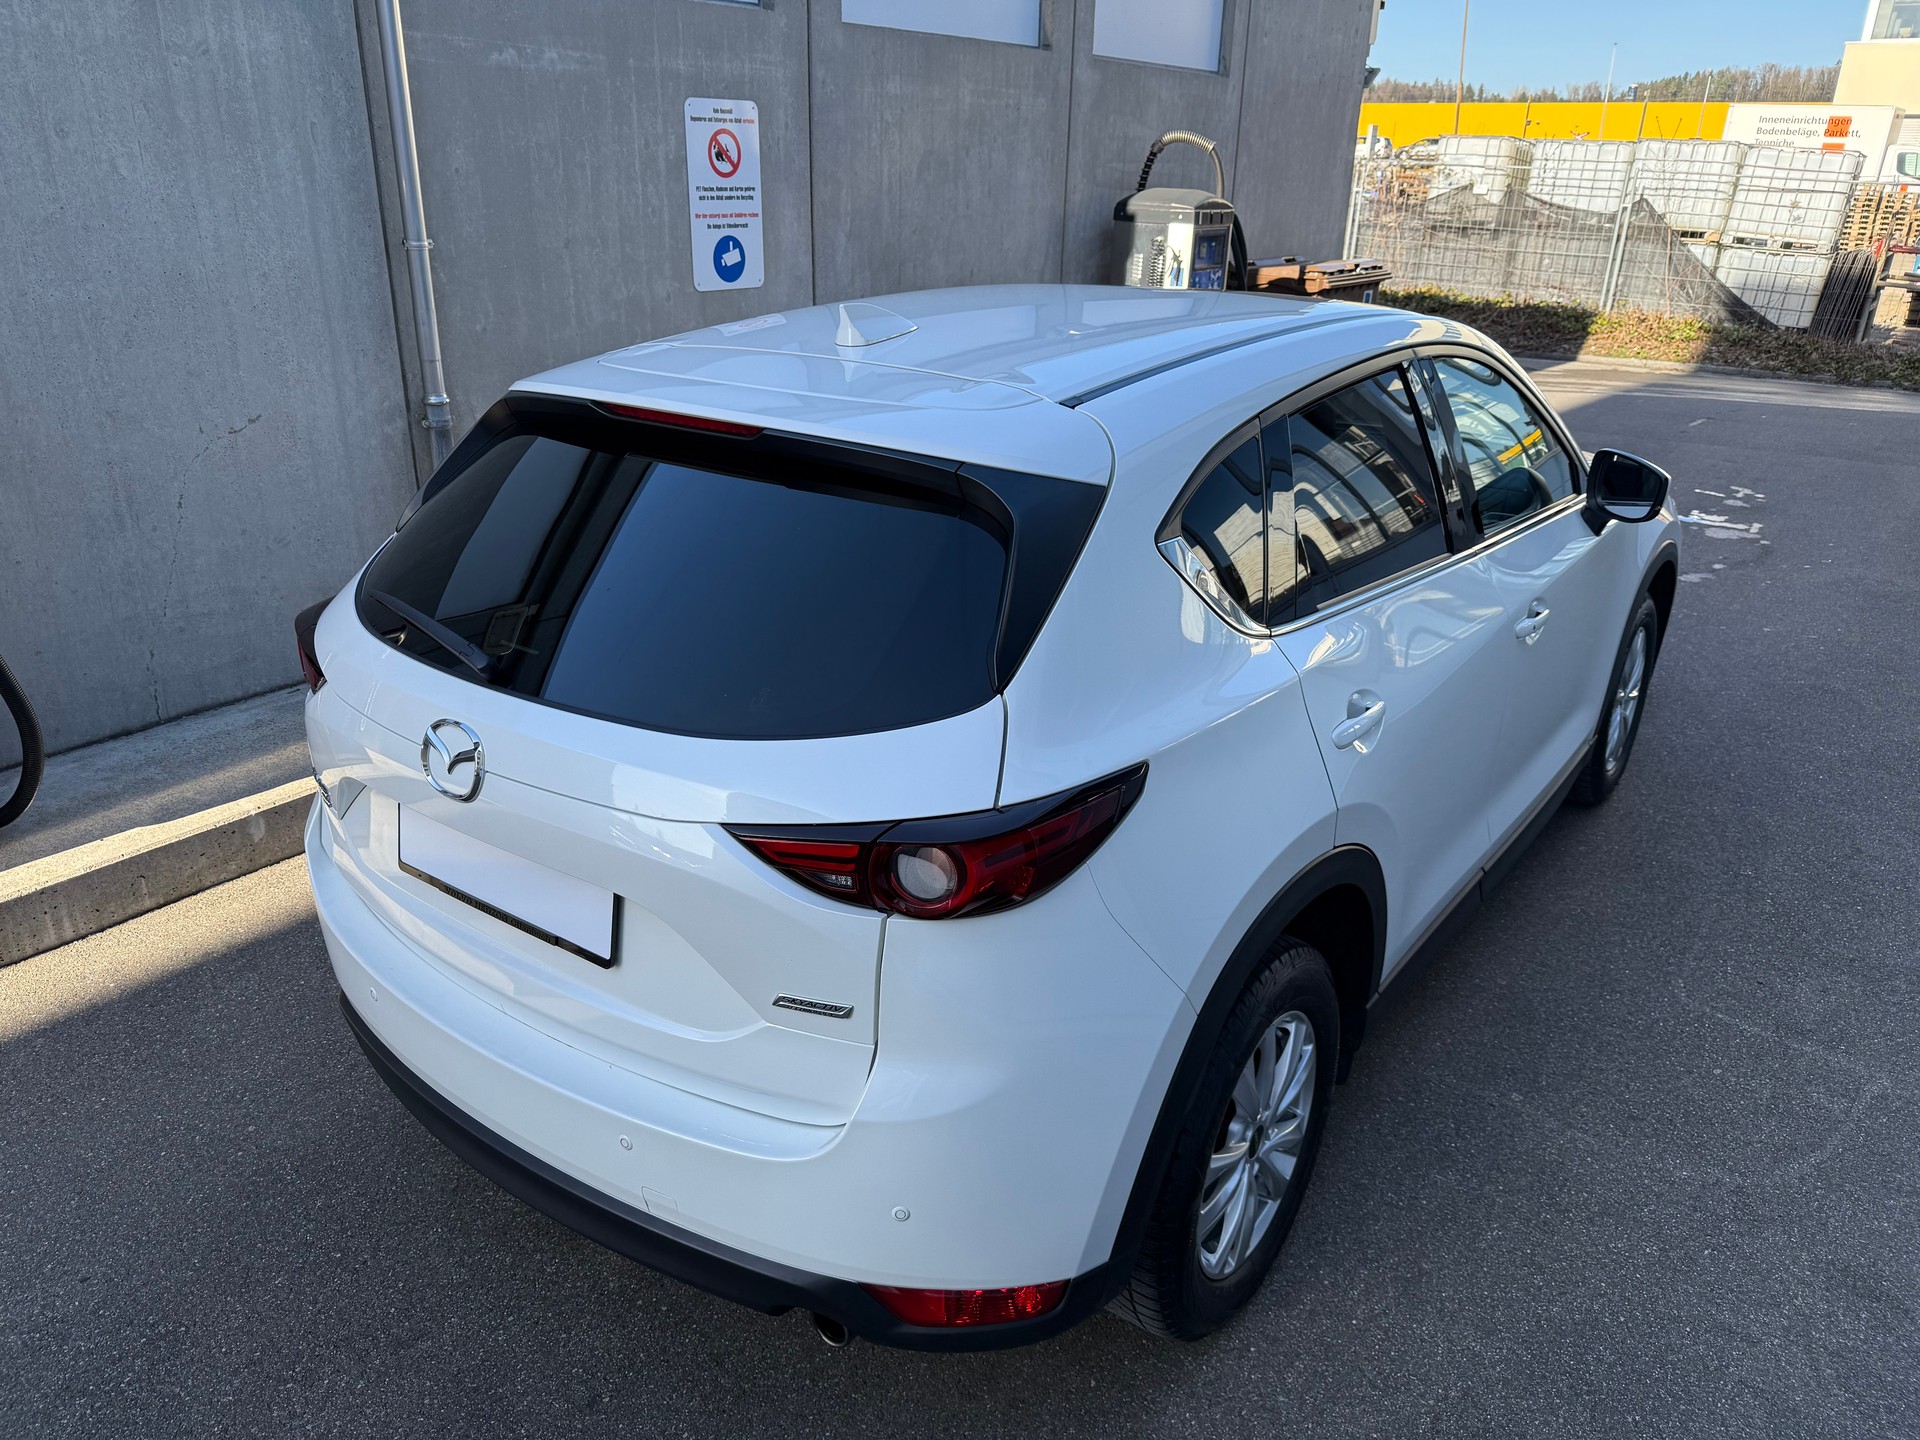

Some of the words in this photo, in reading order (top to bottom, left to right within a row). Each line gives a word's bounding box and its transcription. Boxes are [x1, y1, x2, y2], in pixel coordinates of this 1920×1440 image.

[1758, 115, 1853, 126] Inneneinrichtungen
[1756, 126, 1820, 138] Bodenbeläge,
[1823, 128, 1862, 139] Parkett,
[782, 996, 844, 1013] SKYACTIV
